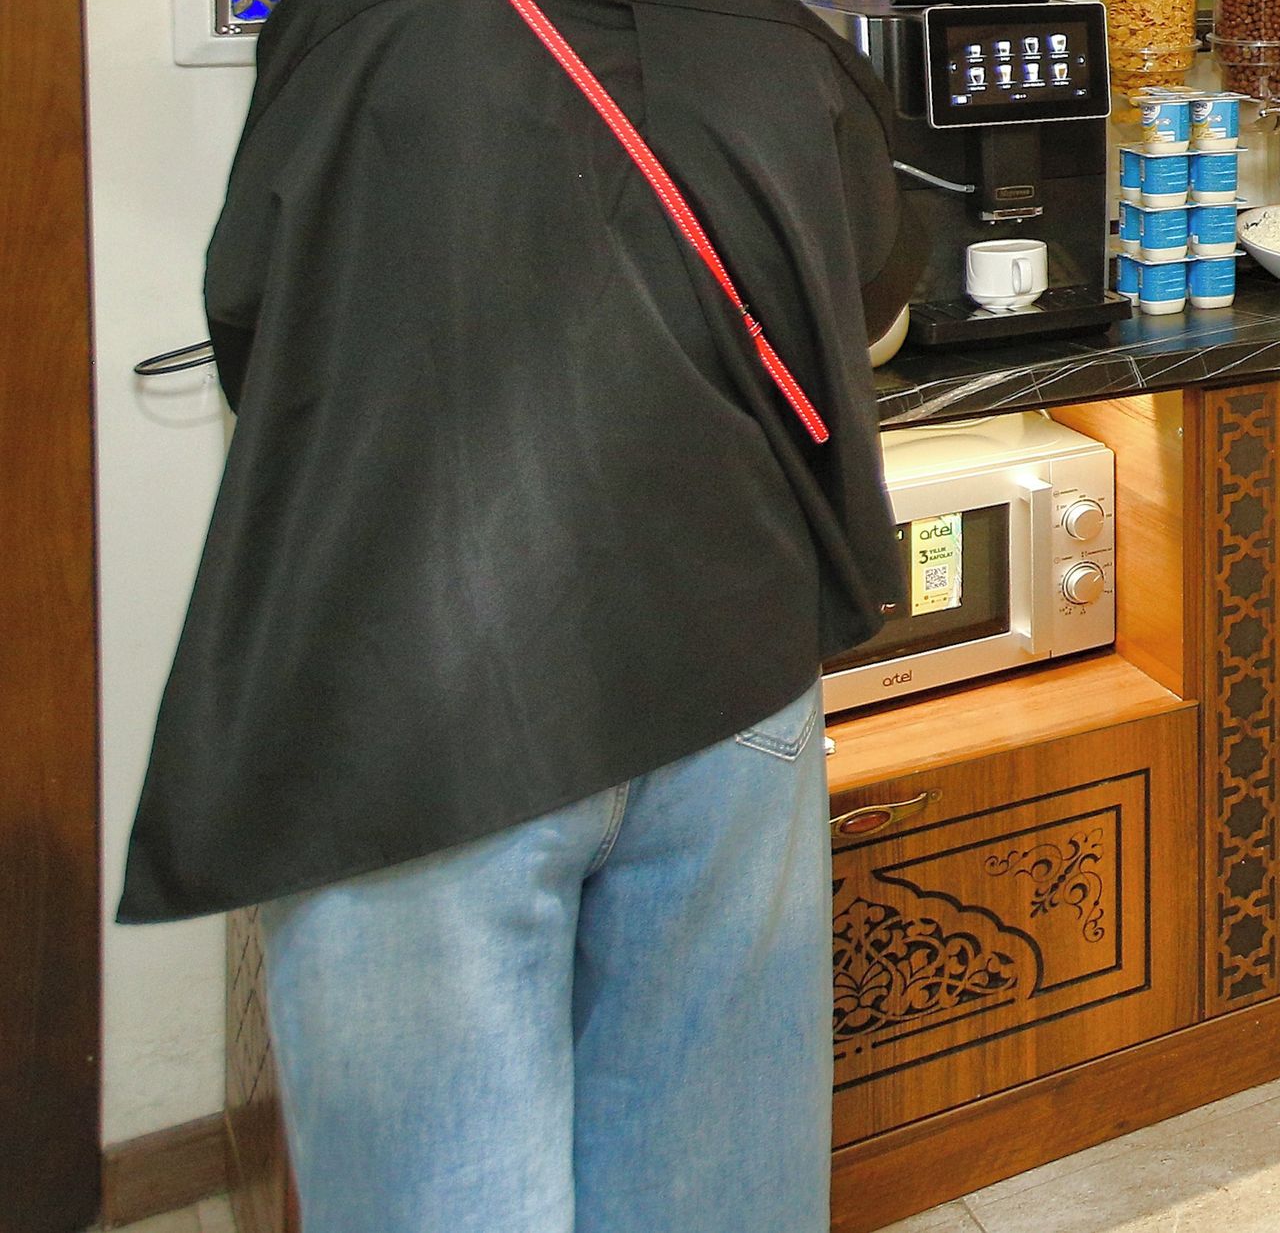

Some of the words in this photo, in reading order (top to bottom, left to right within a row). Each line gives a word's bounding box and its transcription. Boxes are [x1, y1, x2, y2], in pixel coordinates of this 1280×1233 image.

[919, 522, 953, 541] artel
[918, 549, 929, 565] 3
[882, 669, 913, 687] artel
